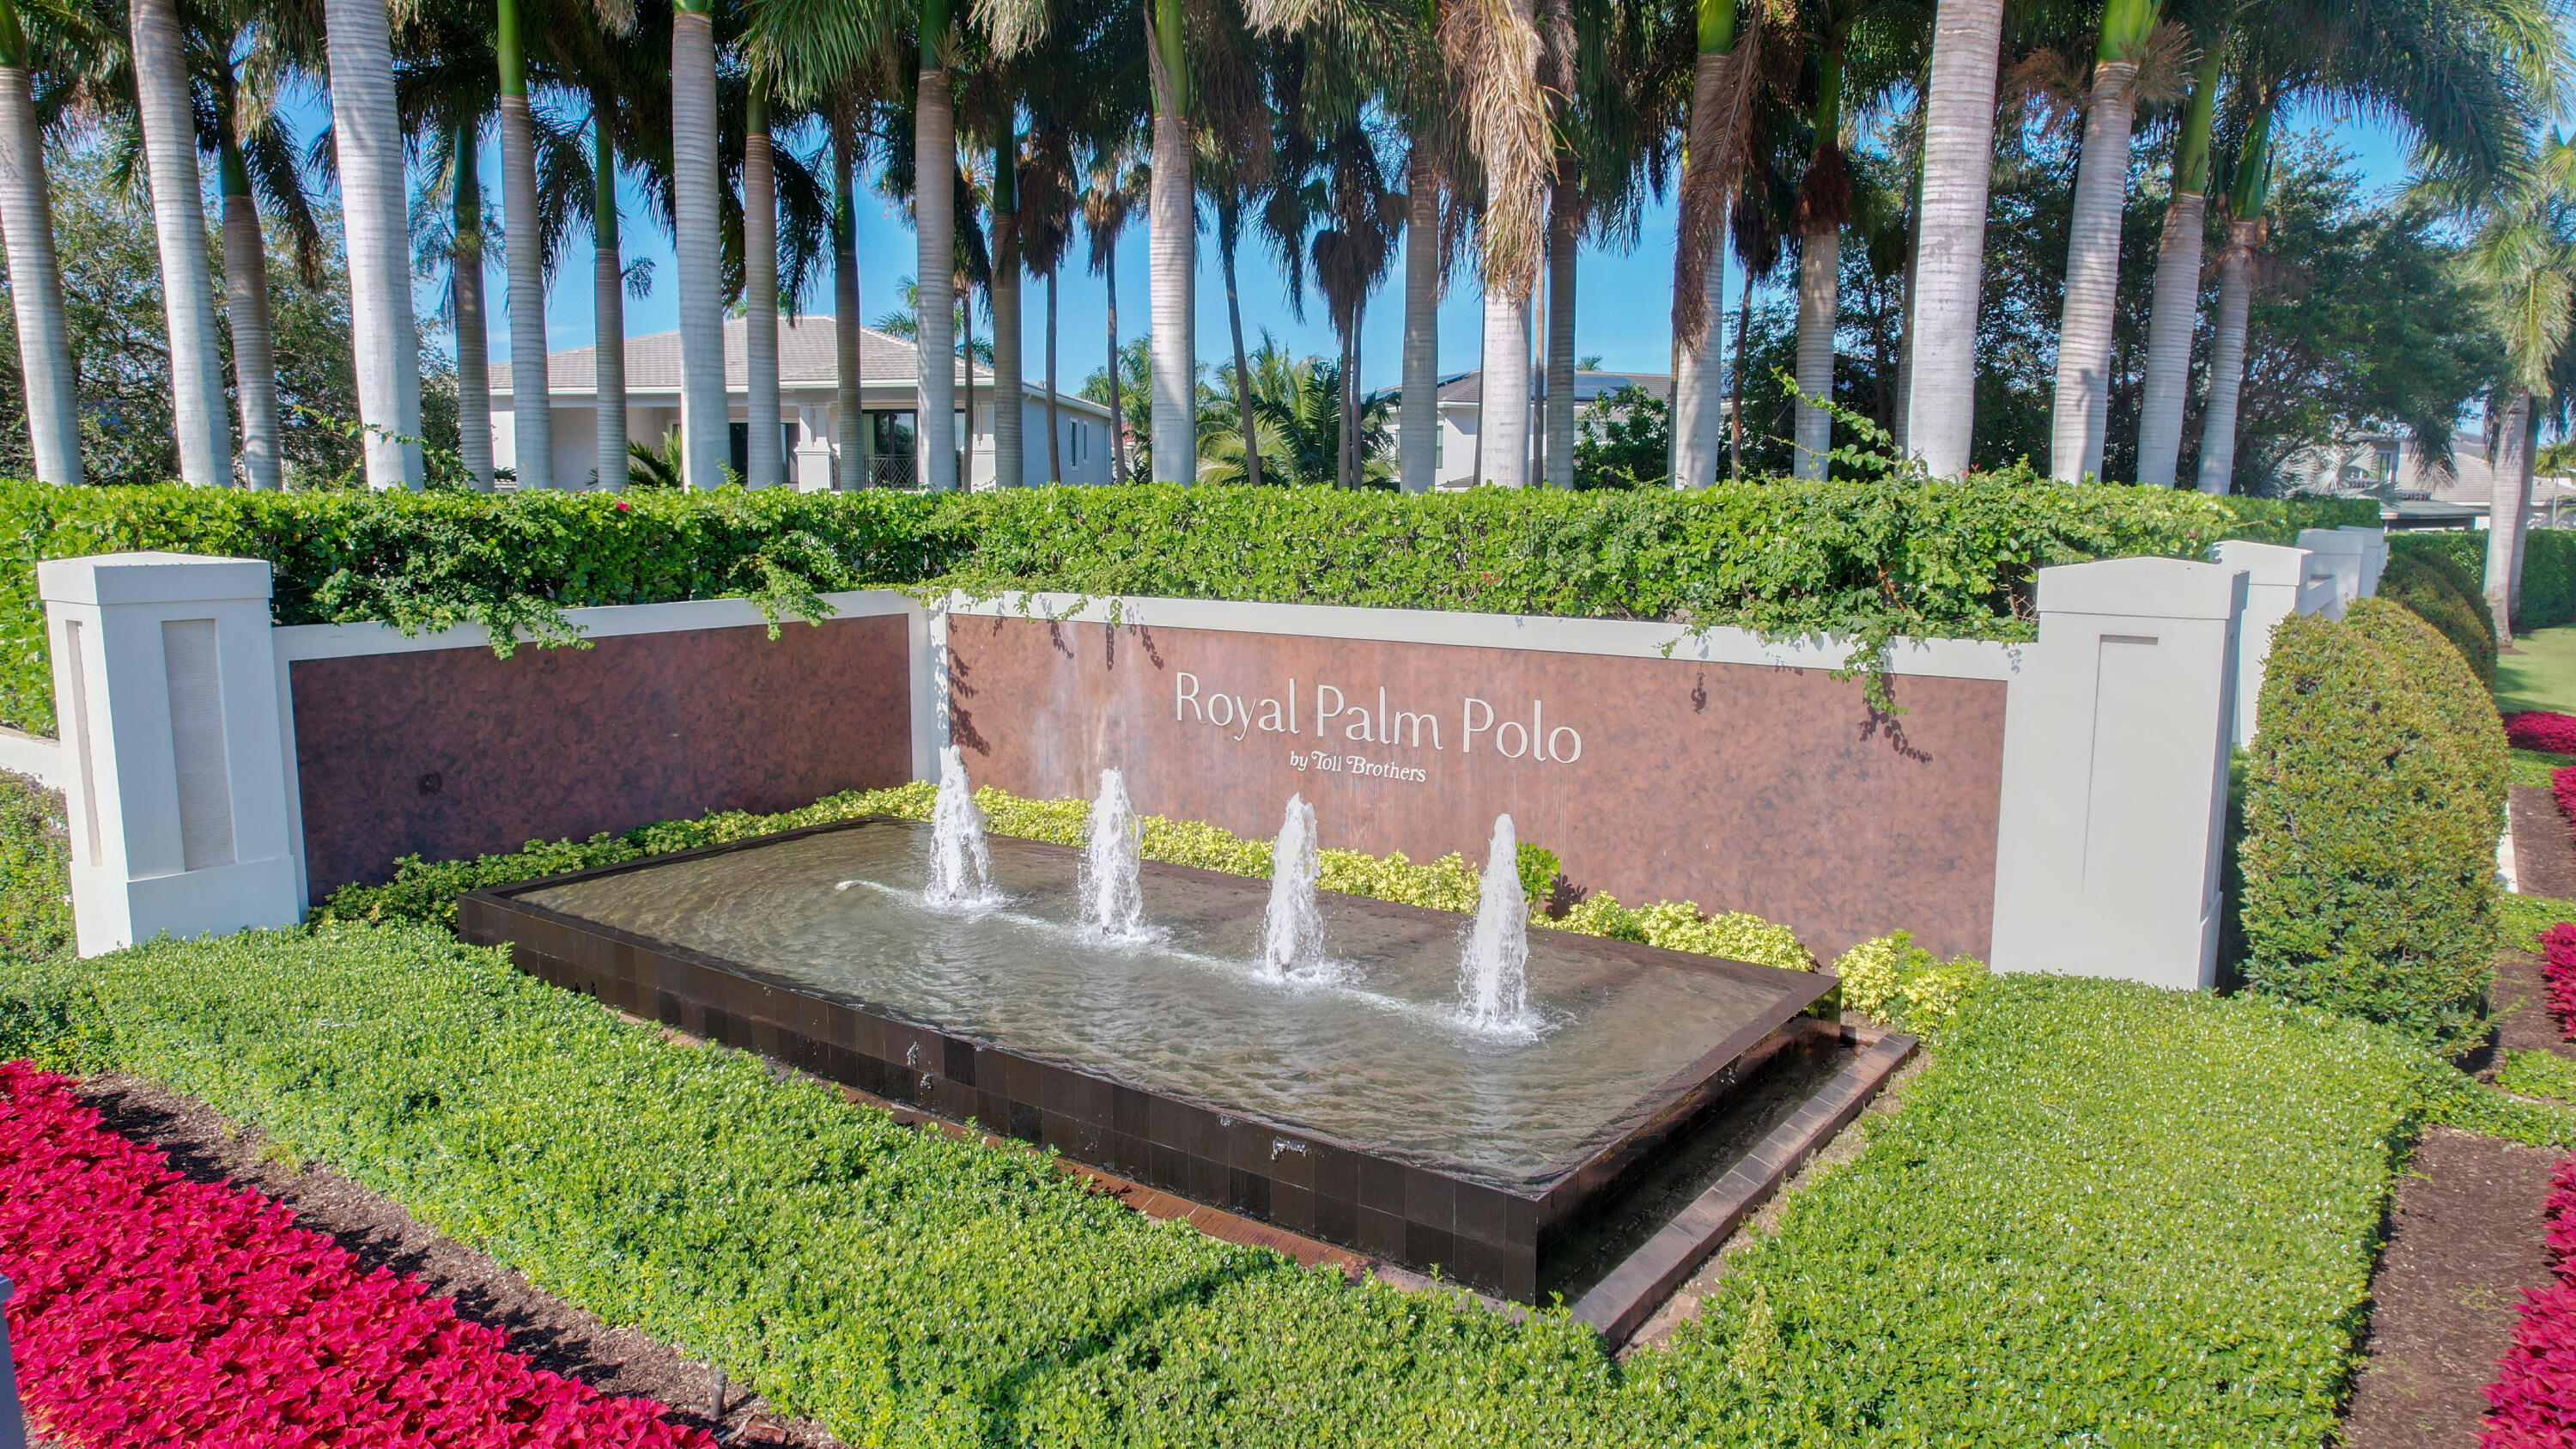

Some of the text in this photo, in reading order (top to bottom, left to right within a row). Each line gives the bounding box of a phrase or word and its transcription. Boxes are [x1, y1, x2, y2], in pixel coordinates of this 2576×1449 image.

[1176, 672, 1583, 764] Royal Palm Polo
[1290, 751, 1427, 782] by Toll Brothers
